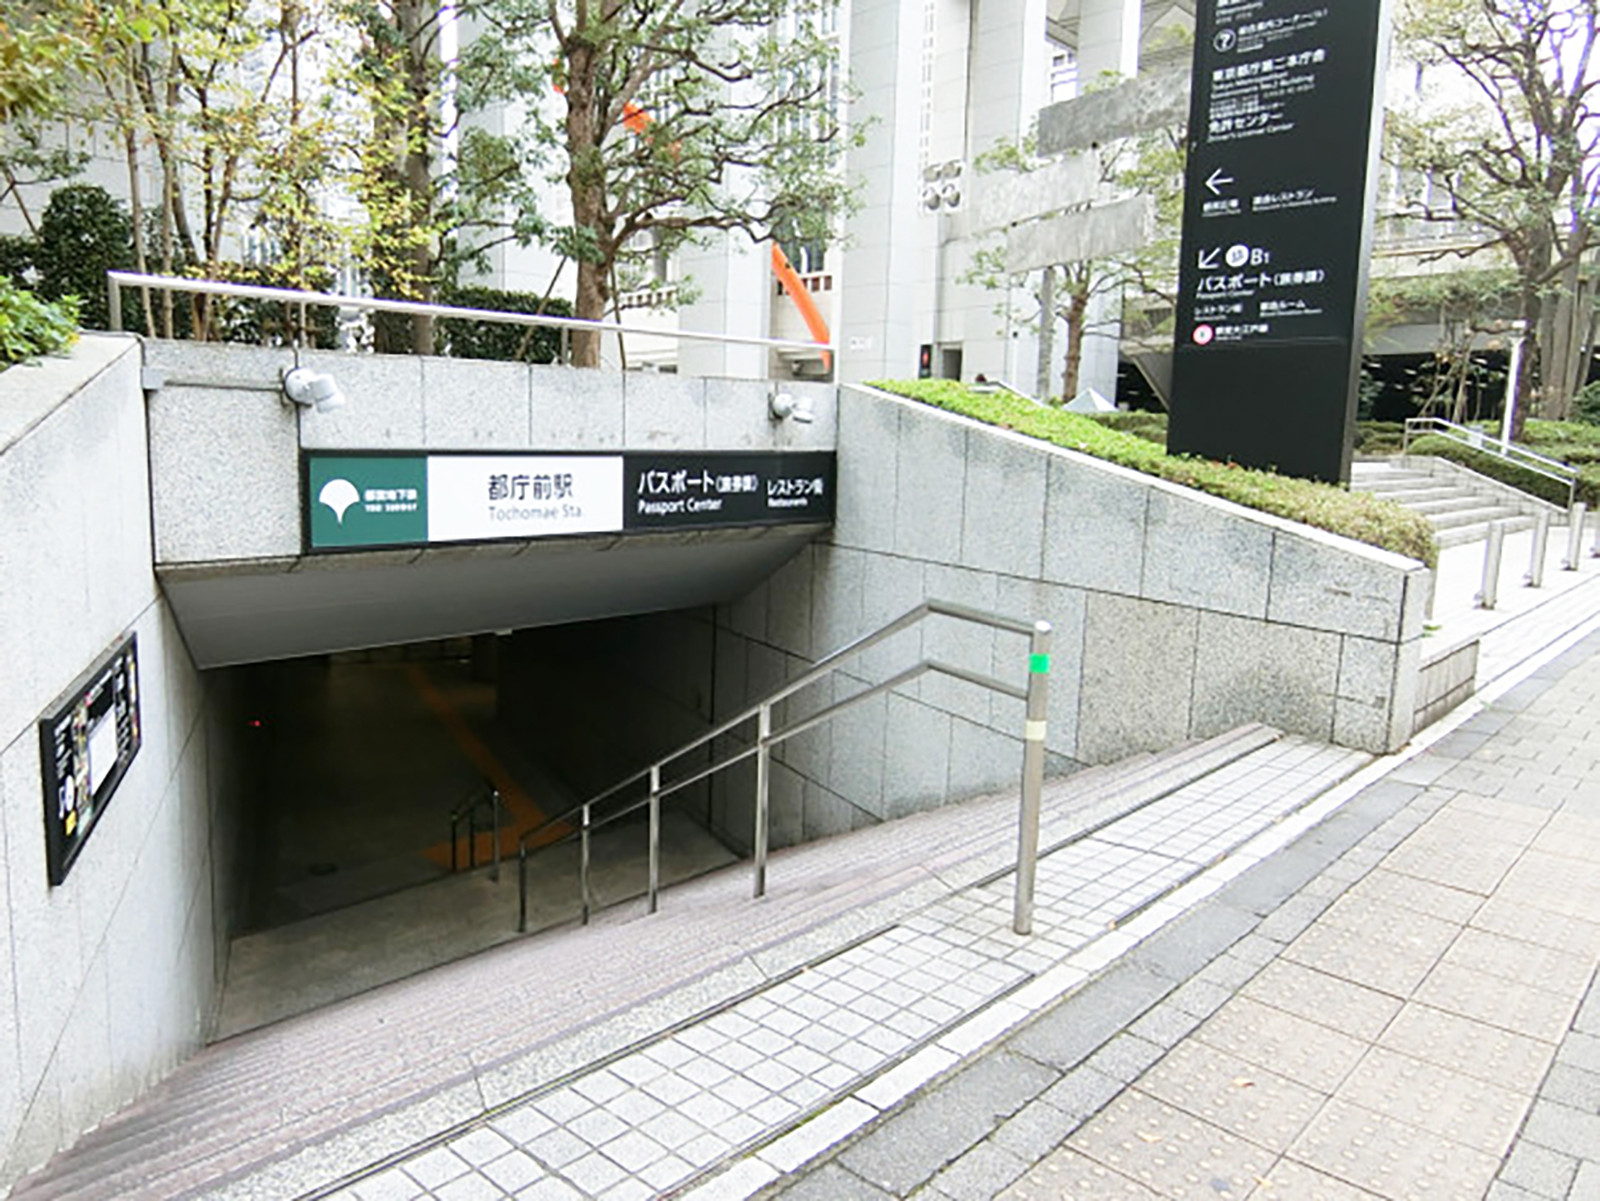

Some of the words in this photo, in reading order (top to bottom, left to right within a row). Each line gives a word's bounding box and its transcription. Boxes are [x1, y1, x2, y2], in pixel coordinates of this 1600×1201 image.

[1250, 248, 1270, 266] B1
[488, 473, 574, 500] 都庁前駅
[637, 498, 686, 515] Passport
[686, 497, 724, 512] Center
